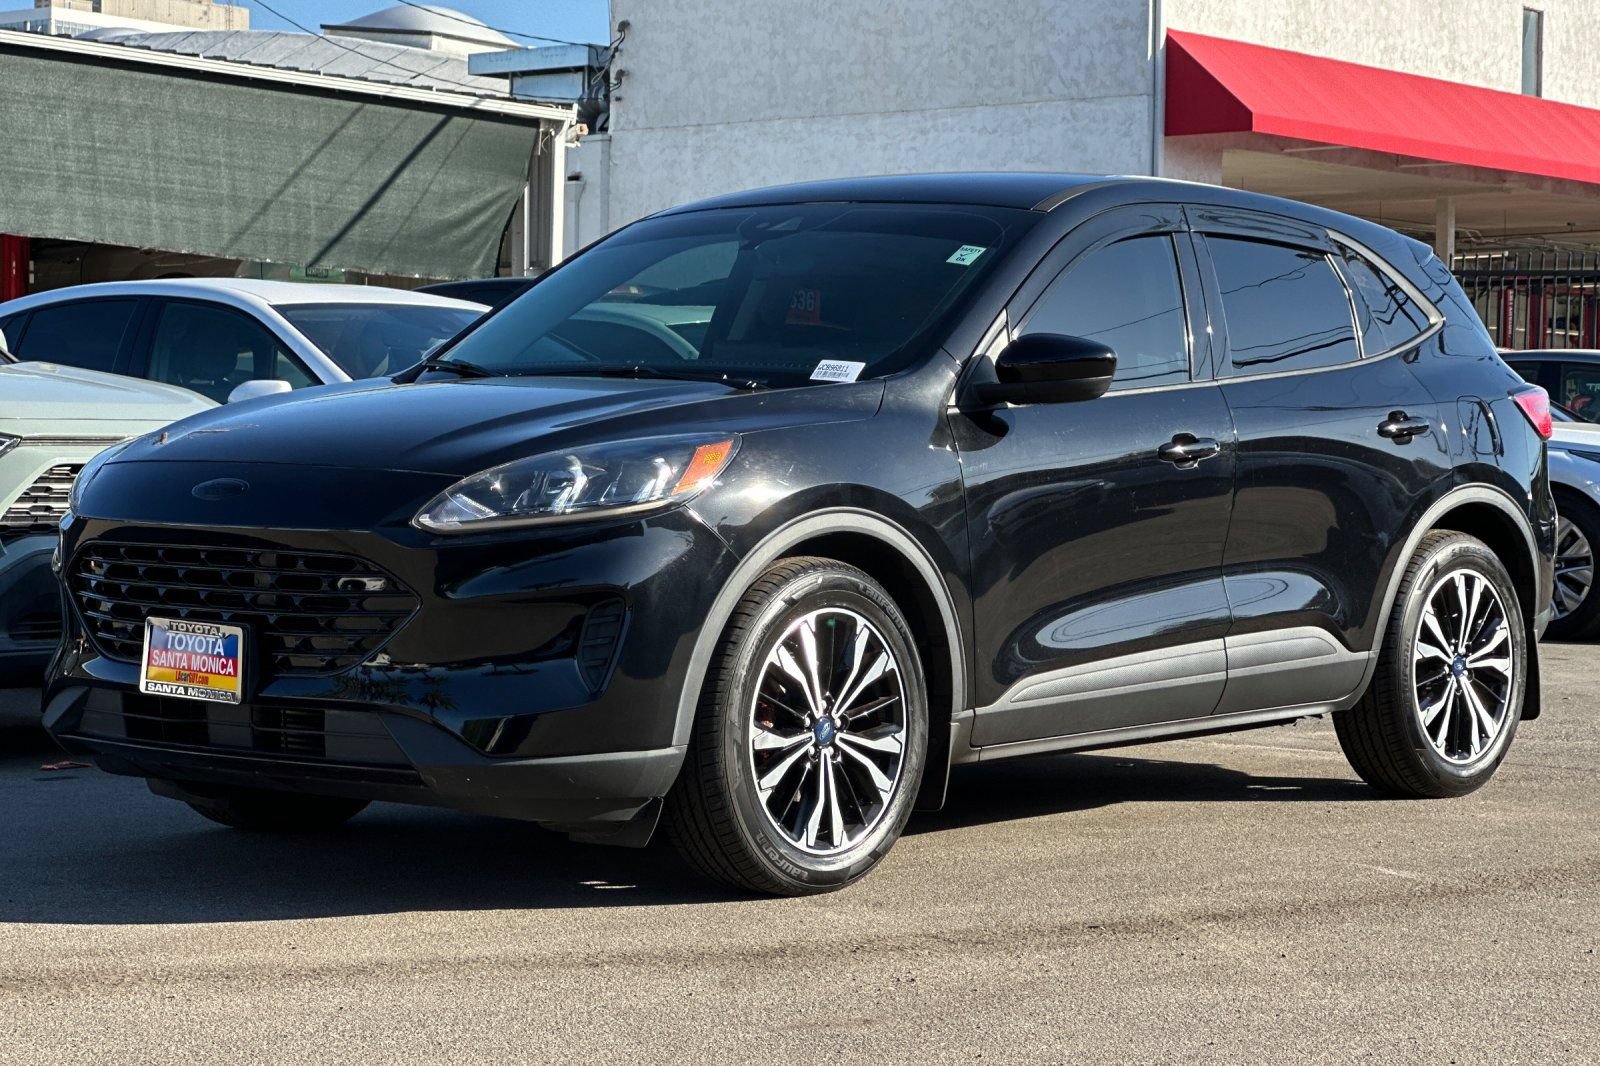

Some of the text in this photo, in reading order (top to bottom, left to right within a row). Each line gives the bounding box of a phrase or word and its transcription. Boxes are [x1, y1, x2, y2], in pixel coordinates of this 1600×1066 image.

[170, 621, 218, 635] TOYOTA
[166, 632, 225, 656] TOYOTA
[152, 650, 234, 676] SANTA MONICA
[147, 682, 233, 701] SANTA MONICA
